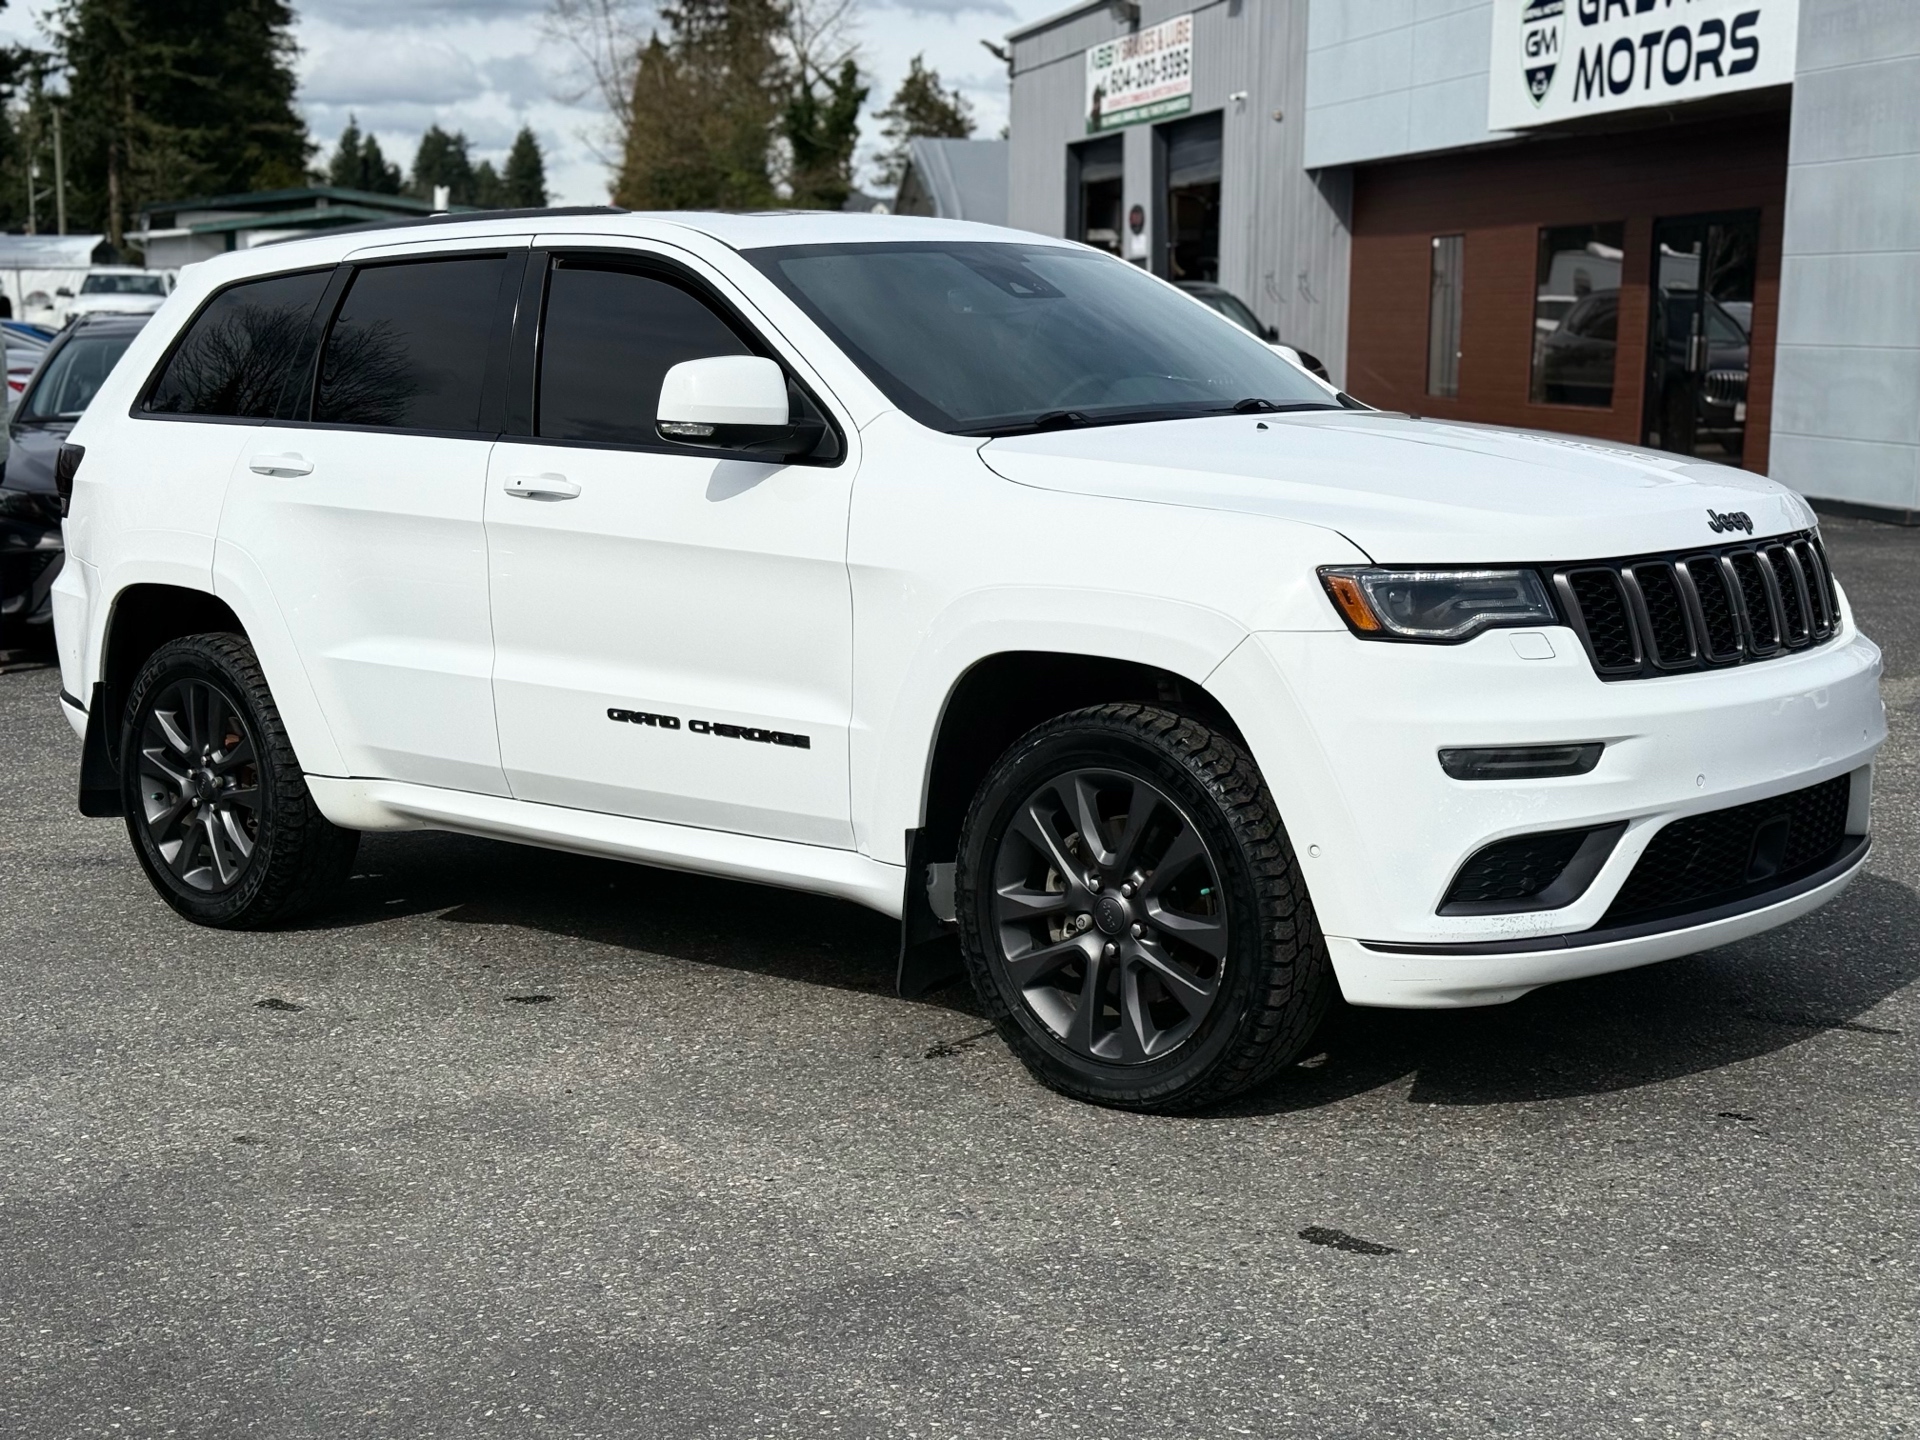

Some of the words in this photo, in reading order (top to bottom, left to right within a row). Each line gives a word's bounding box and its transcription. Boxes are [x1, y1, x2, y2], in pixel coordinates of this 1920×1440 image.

[1525, 26, 1557, 57] GM
[1573, 9, 1761, 103] MOTORS
[1706, 508, 1754, 536] Jeep
[607, 707, 681, 730] GRAND
[688, 719, 811, 750] CHEROKEE
